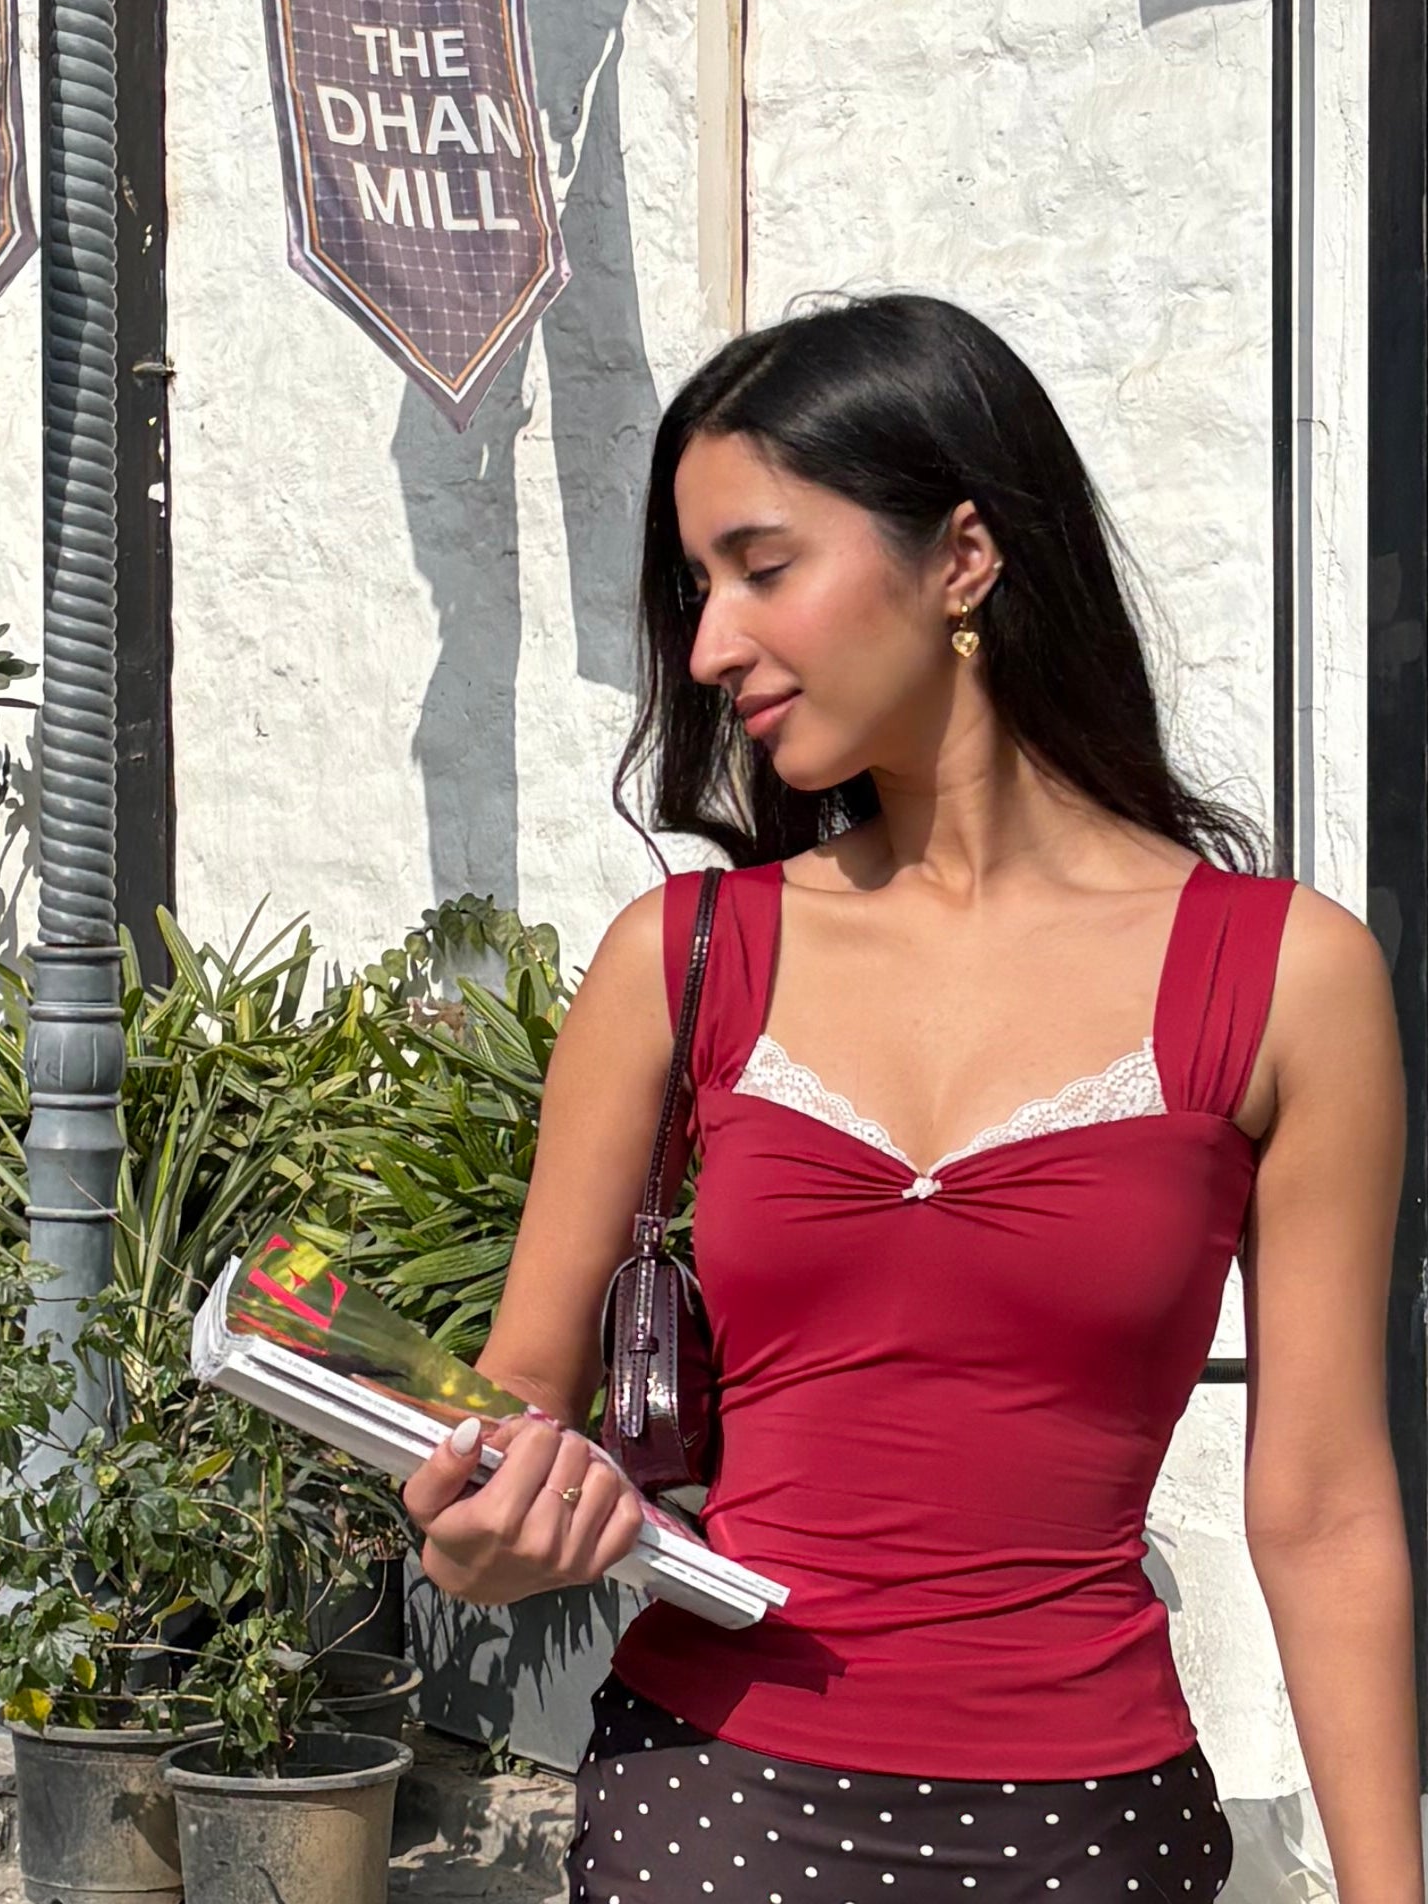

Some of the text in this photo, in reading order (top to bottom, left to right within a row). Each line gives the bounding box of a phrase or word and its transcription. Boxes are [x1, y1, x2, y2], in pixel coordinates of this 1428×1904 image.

[352, 24, 471, 80] THE
[313, 86, 523, 158] DHAN
[352, 159, 521, 232] MILL
